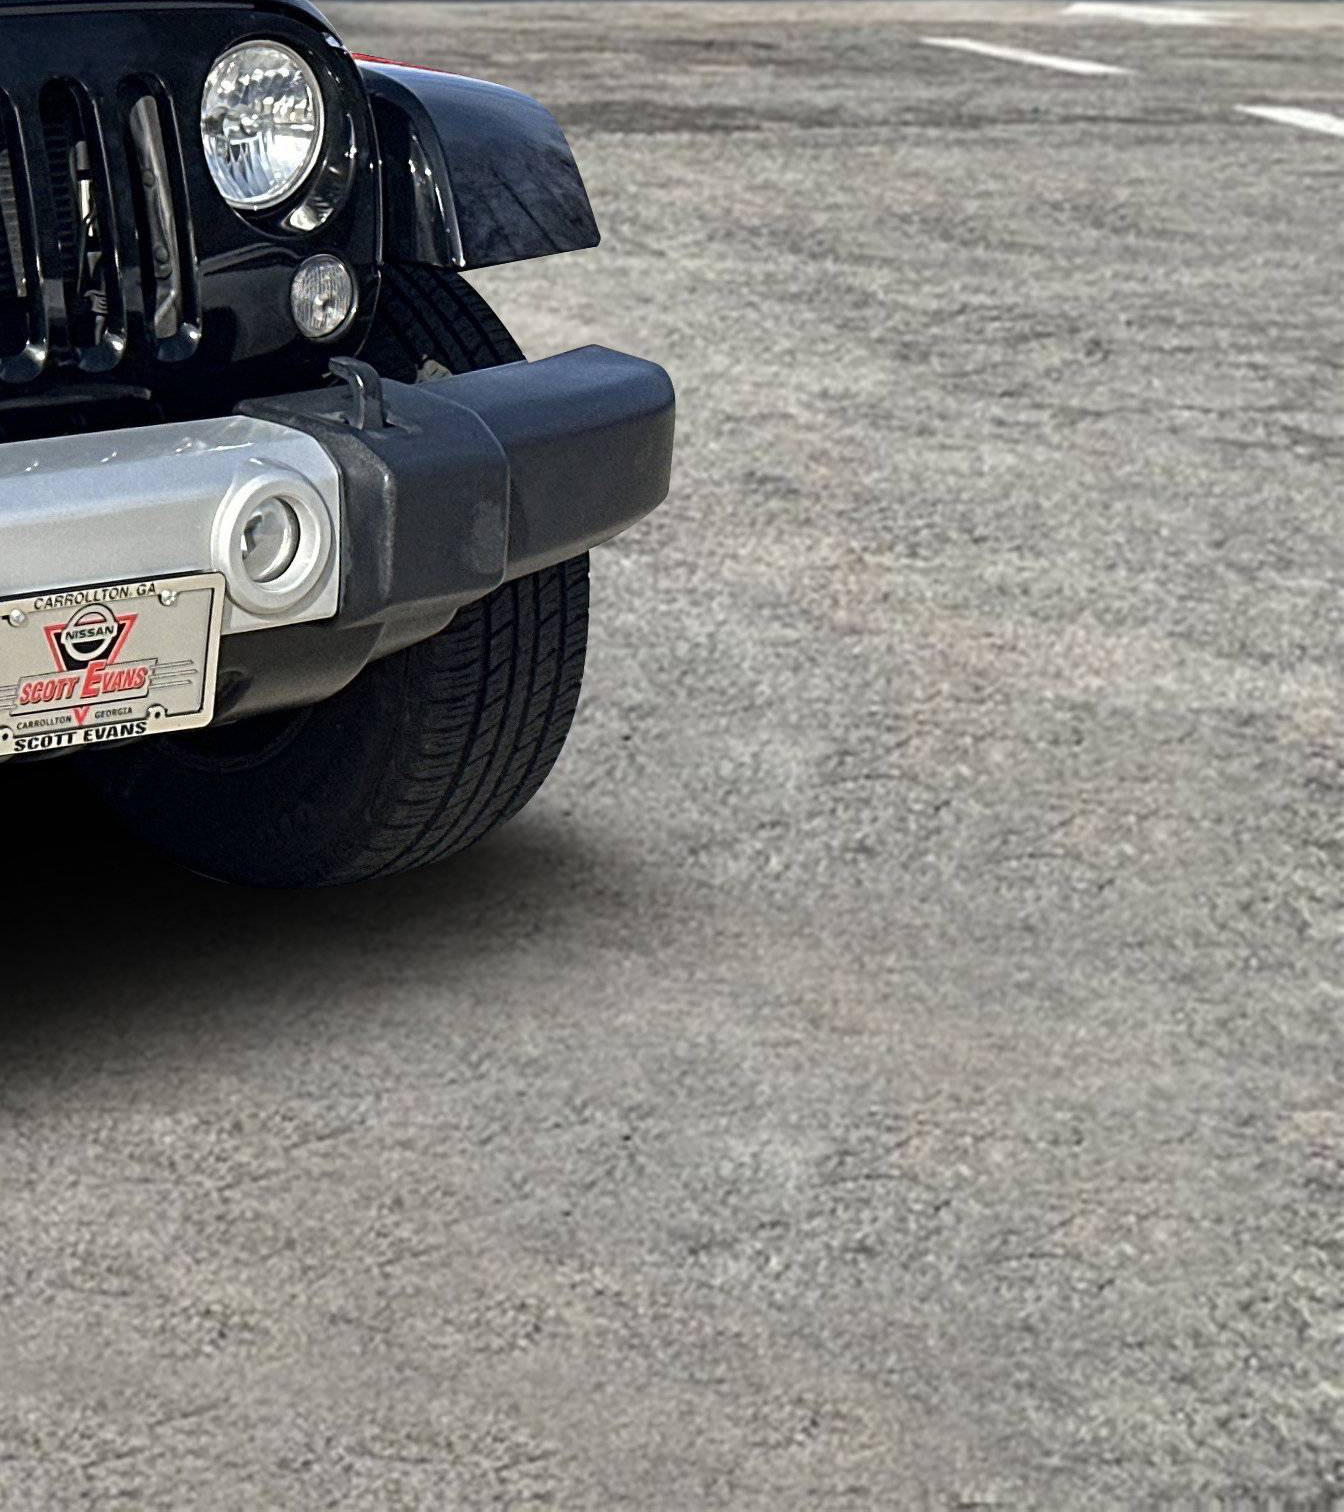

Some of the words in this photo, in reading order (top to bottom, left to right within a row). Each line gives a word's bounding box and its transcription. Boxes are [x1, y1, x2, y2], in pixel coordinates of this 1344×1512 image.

[135, 582, 157, 597] GA
[65, 625, 115, 641] NISSAN
[19, 676, 79, 704] SCOTT
[81, 660, 148, 698] EVANS
[94, 706, 133, 719] GEORGIA
[16, 714, 72, 730] CARROLLTON
[14, 733, 75, 752] SCOTT
[83, 720, 148, 741] EVANS
